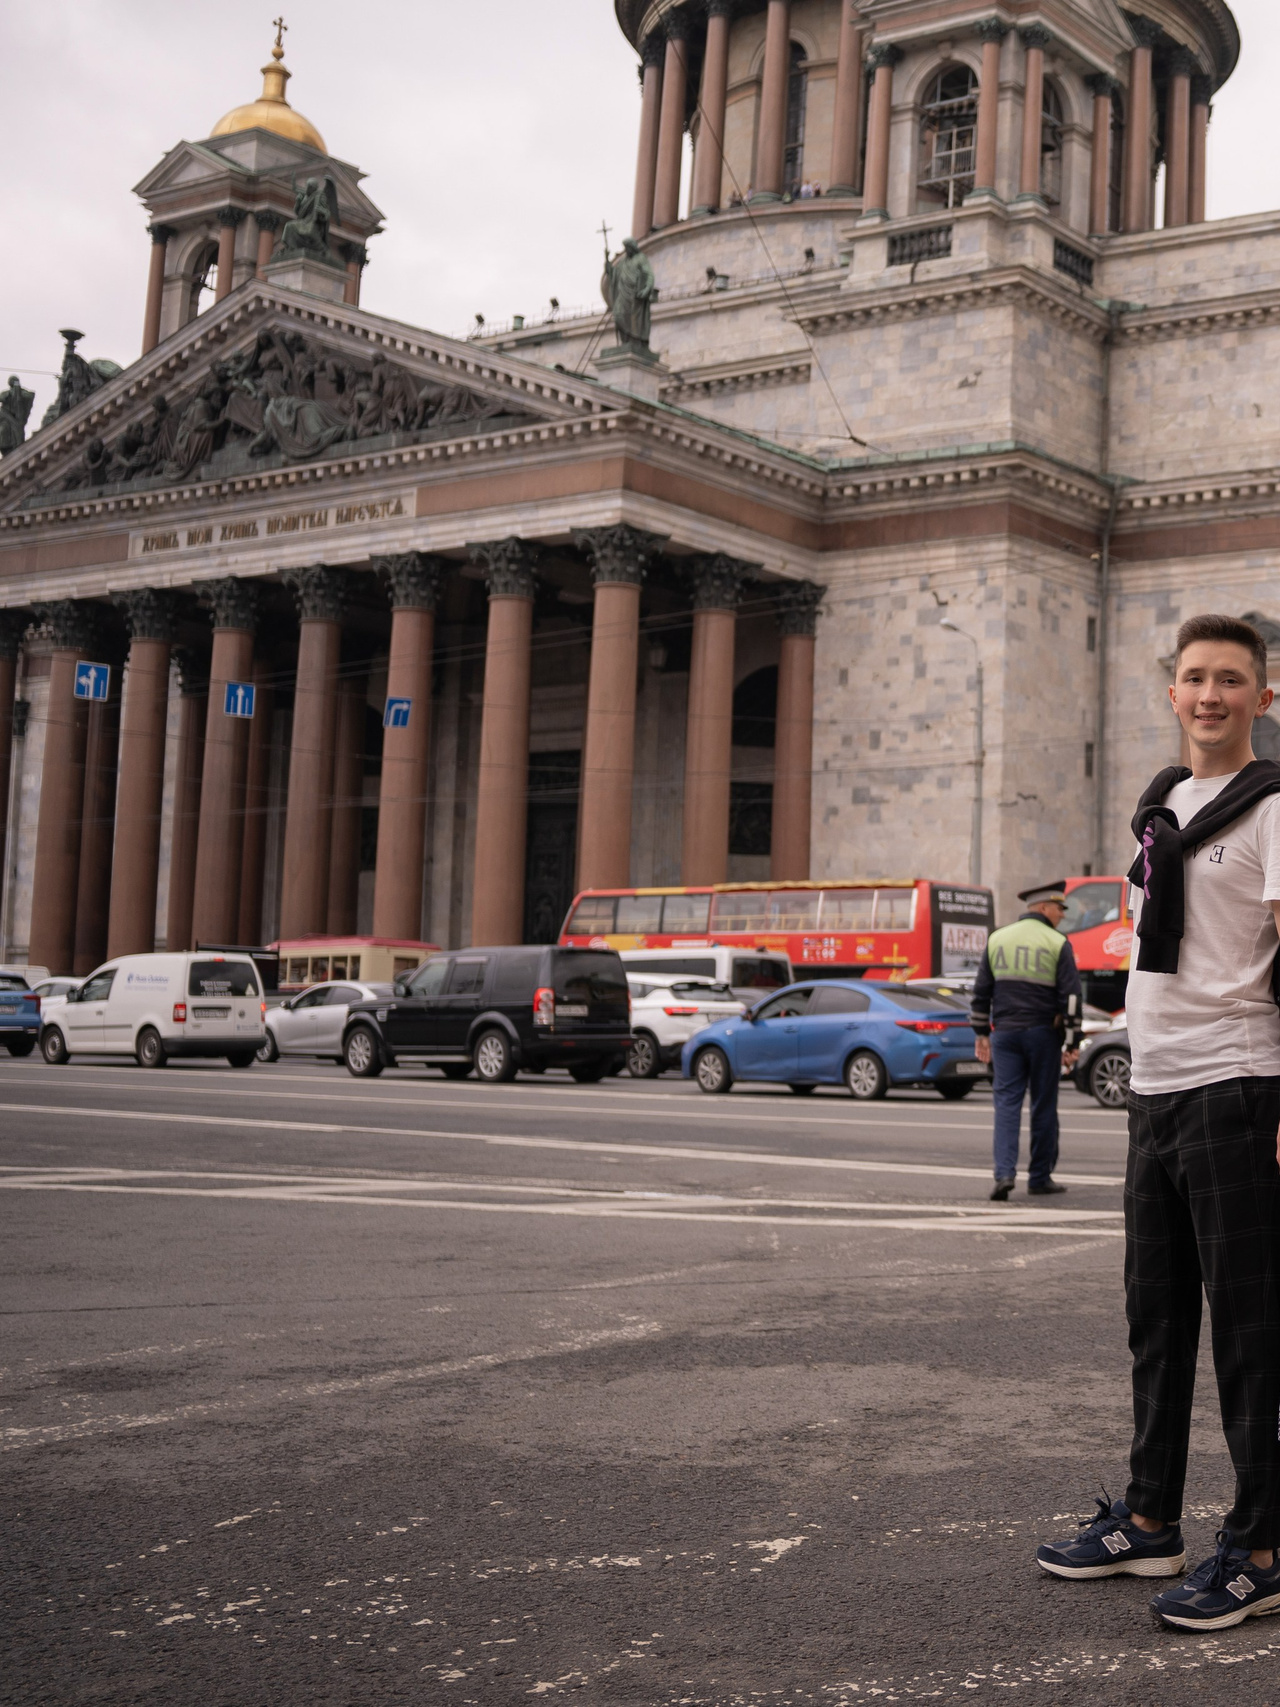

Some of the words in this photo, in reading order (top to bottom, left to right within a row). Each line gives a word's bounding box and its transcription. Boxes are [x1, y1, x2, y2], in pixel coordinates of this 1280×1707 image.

[994, 945, 1051, 973] ДПС
[1101, 1530, 1132, 1555] N
[1225, 1574, 1256, 1601] N
